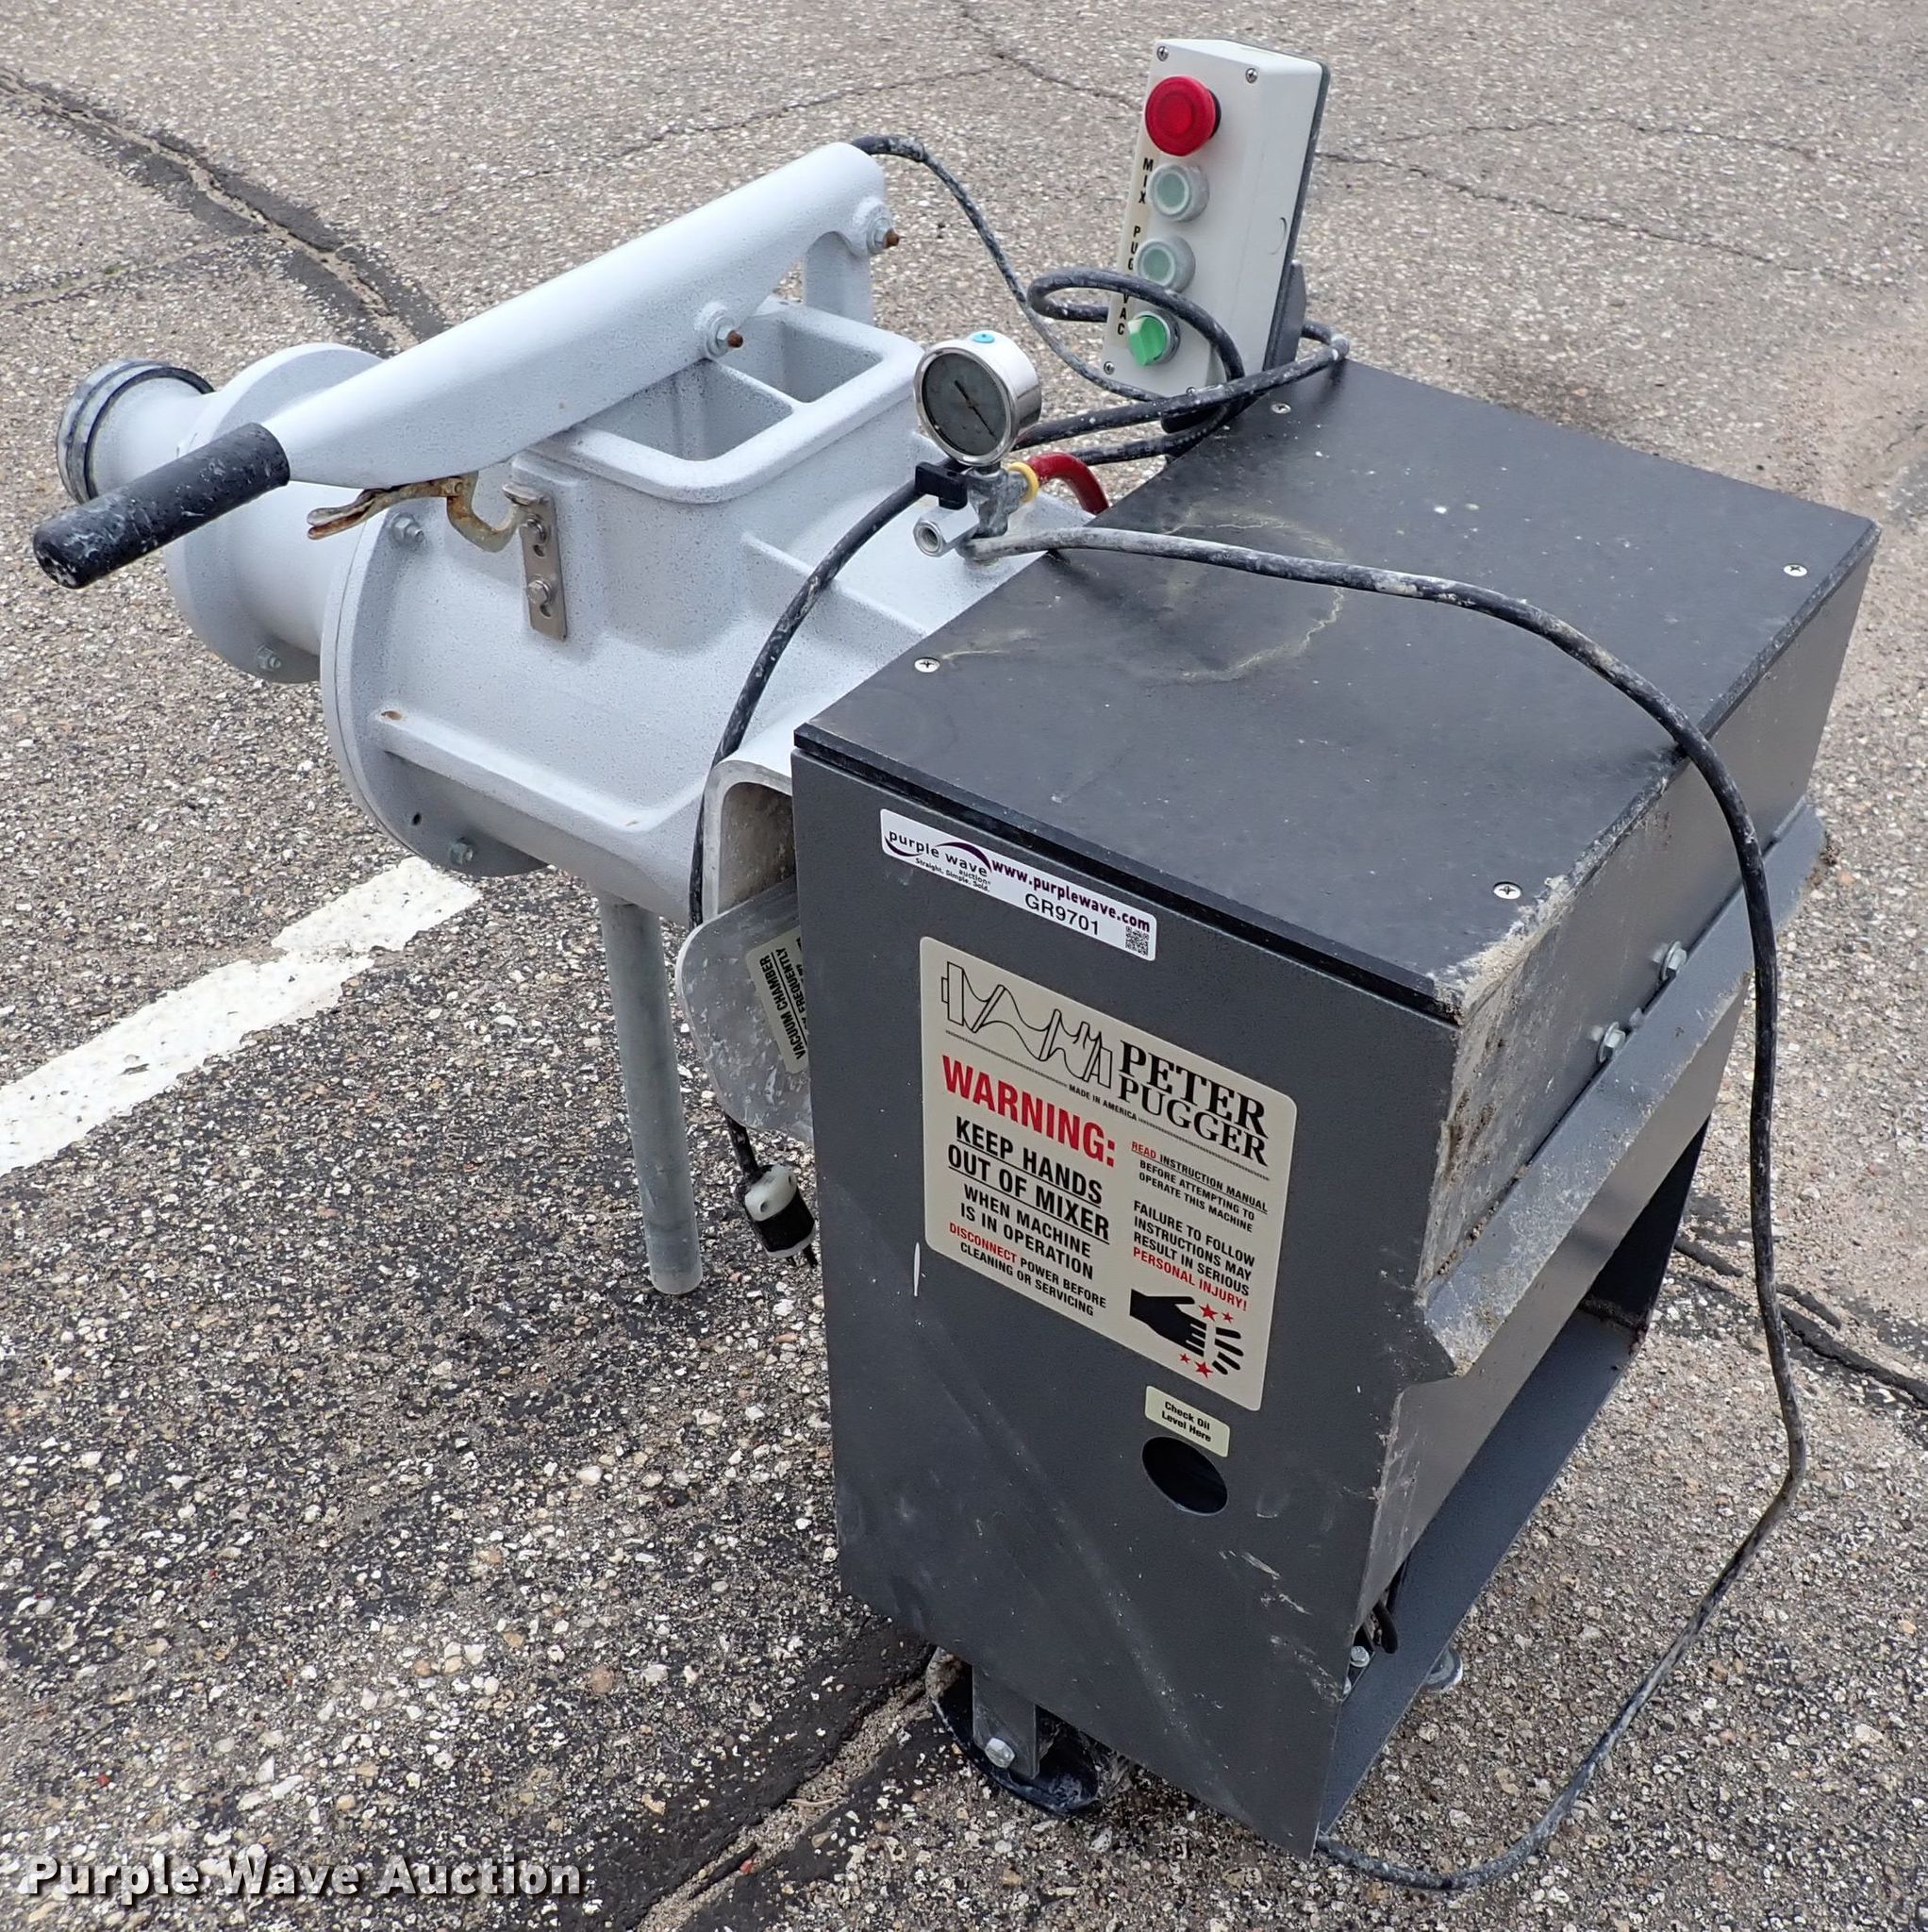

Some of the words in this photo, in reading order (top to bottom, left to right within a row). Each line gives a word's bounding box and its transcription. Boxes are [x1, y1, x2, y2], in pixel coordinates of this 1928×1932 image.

[1139, 158, 1154, 204] MIX
[1117, 293, 1129, 335] VAC
[889, 831, 939, 858] purple
[945, 853, 988, 877] wave
[990, 859, 1150, 932] www.purplewave.com
[1025, 893, 1099, 935] GR9701
[759, 955, 789, 1011] CHAMBER
[775, 947, 806, 1013] FREQUENTLY
[780, 1010, 806, 1059] VACUUM
[942, 1055, 1116, 1168] WARNING:
[1069, 1084, 1090, 1100] MADE
[1092, 1094, 1101, 1105] IN
[1103, 1100, 1138, 1121] AMERICA
[1118, 1040, 1270, 1140] PETER
[1118, 1074, 1269, 1167] PUGGER
[948, 1144, 990, 1182] OUT
[999, 1168, 1027, 1198] OF
[1036, 1184, 1110, 1241] MIXER
[956, 1115, 1014, 1159] KEEP
[1023, 1147, 1103, 1205] HANDS
[1132, 1141, 1156, 1158] READ
[1159, 1154, 1223, 1191] INSTRUCTION
[1226, 1186, 1268, 1212] MANUAL
[1139, 1159, 1176, 1184] BEFORE
[1179, 1178, 1239, 1213] ATTEMPTING
[1242, 1208, 1255, 1221] TO
[963, 1183, 1010, 1219] WHEN
[1017, 1209, 1091, 1258] MACHINE
[1134, 1200, 1183, 1233] FAILURE
[1187, 1224, 1202, 1241] TO
[1205, 1235, 1255, 1267] FOLLOW
[1139, 1172, 1181, 1199] OPERATE
[1184, 1192, 1205, 1210] THIS
[1208, 1205, 1253, 1233] MACHINE
[949, 1222, 1018, 1264] DISCONNECT
[1020, 1257, 1059, 1285] POWER
[1063, 1278, 1106, 1308] BEFORE
[960, 1203, 975, 1222] IS
[981, 1212, 997, 1233] IN
[1003, 1224, 1093, 1280] OPERATION
[1134, 1216, 1221, 1267] INSTRUCTIONS
[1225, 1259, 1252, 1281] MAY
[1134, 1231, 1178, 1260] RESULT
[1181, 1254, 1193, 1270] IN
[1197, 1262, 1250, 1296] SERIOUS
[960, 1241, 1013, 1276] CLEANING
[1017, 1270, 1032, 1286] OR
[1035, 1279, 1094, 1317] SERVICING
[1133, 1246, 1195, 1286] PERSONAL
[1199, 1278, 1247, 1311] INJURY!
[1161, 1410, 1187, 1429] Level
[1189, 1424, 1211, 1442] Here
[1164, 1401, 1194, 1423] Check
[1197, 1418, 1210, 1430] Oil
